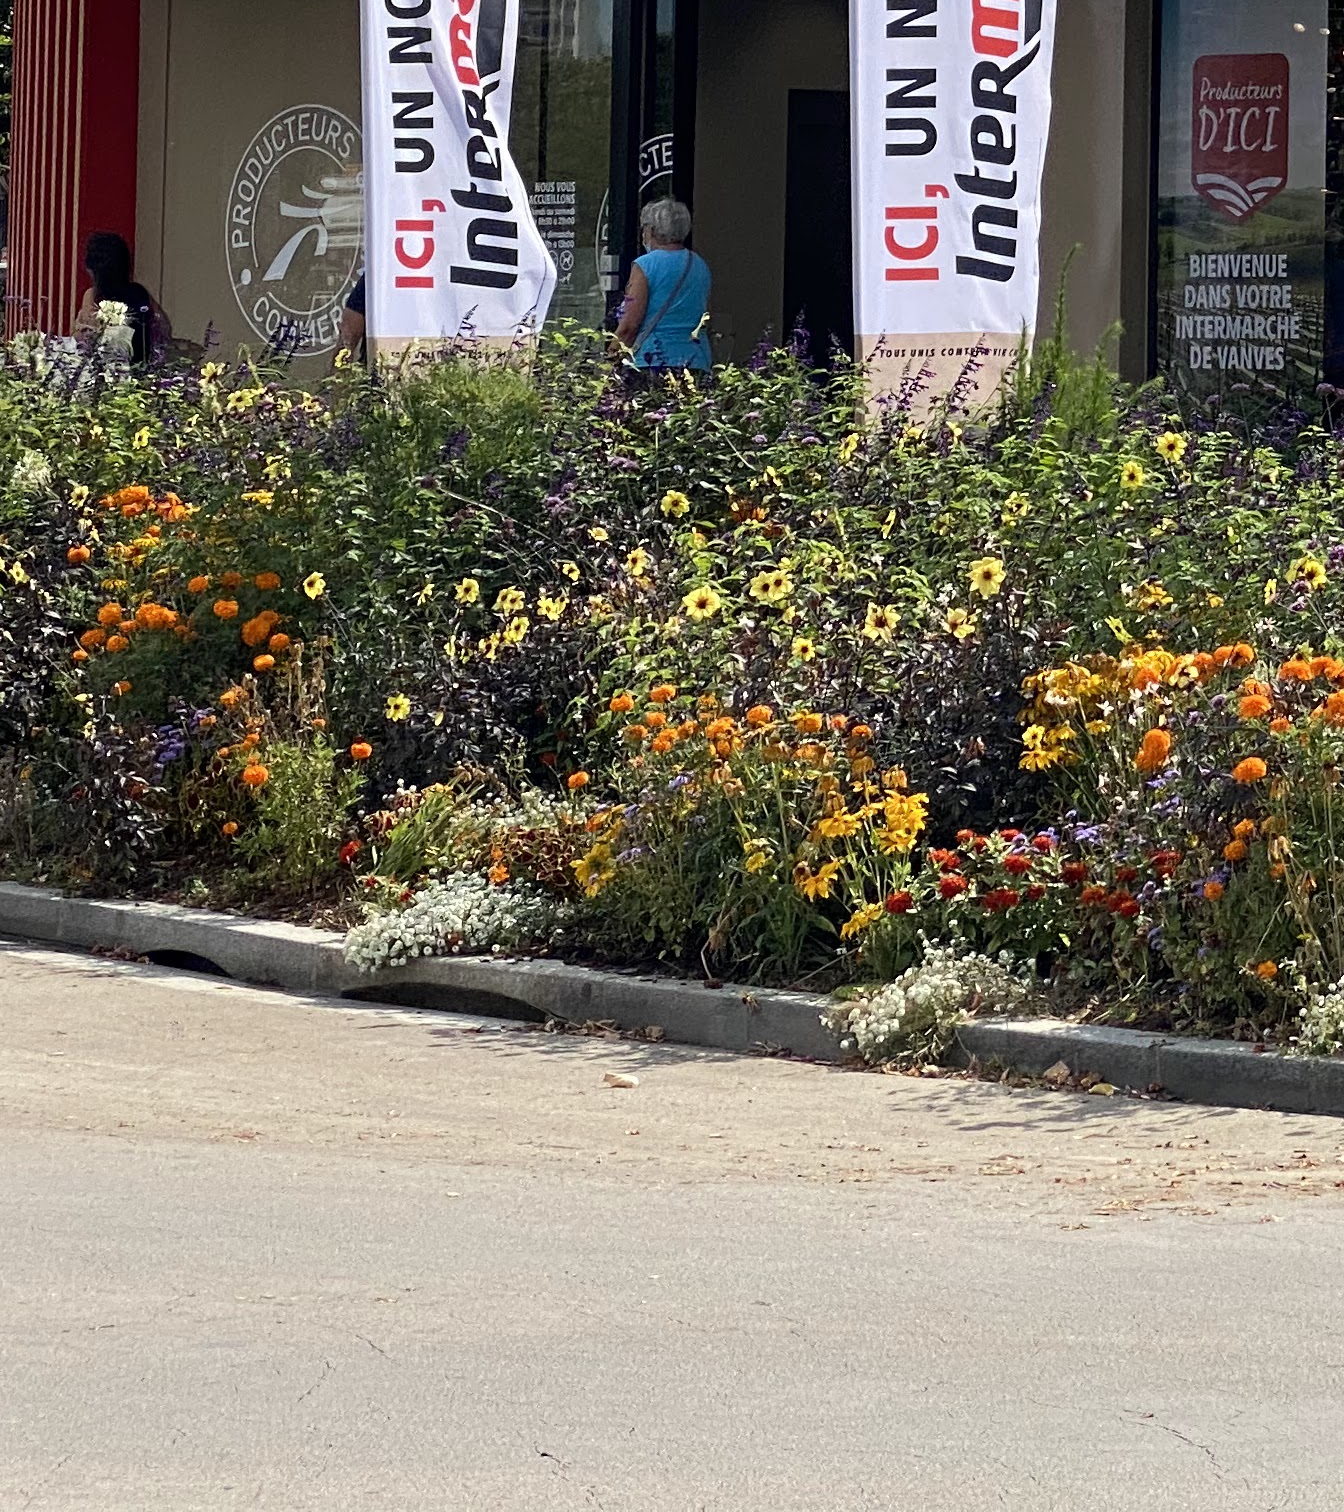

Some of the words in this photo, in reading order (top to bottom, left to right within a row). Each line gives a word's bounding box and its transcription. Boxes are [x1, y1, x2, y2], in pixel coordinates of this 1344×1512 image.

[885, 68, 938, 157] UN
[1200, 76, 1283, 102] Producteurs
[391, 91, 435, 174] UN
[1198, 104, 1281, 153] D'ICI
[231, 112, 355, 249] PRODUCTEURS
[394, 198, 447, 289] ICI,
[884, 184, 950, 281] ICI,
[1189, 254, 1288, 278] BIENVENUE
[1184, 285, 1231, 309] DANS
[1235, 285, 1292, 309] VOTRE
[880, 348, 907, 359] TOUS
[910, 348, 936, 358] UNIS
[1189, 346, 1212, 369] DE
[1217, 346, 1285, 370] VANVES
